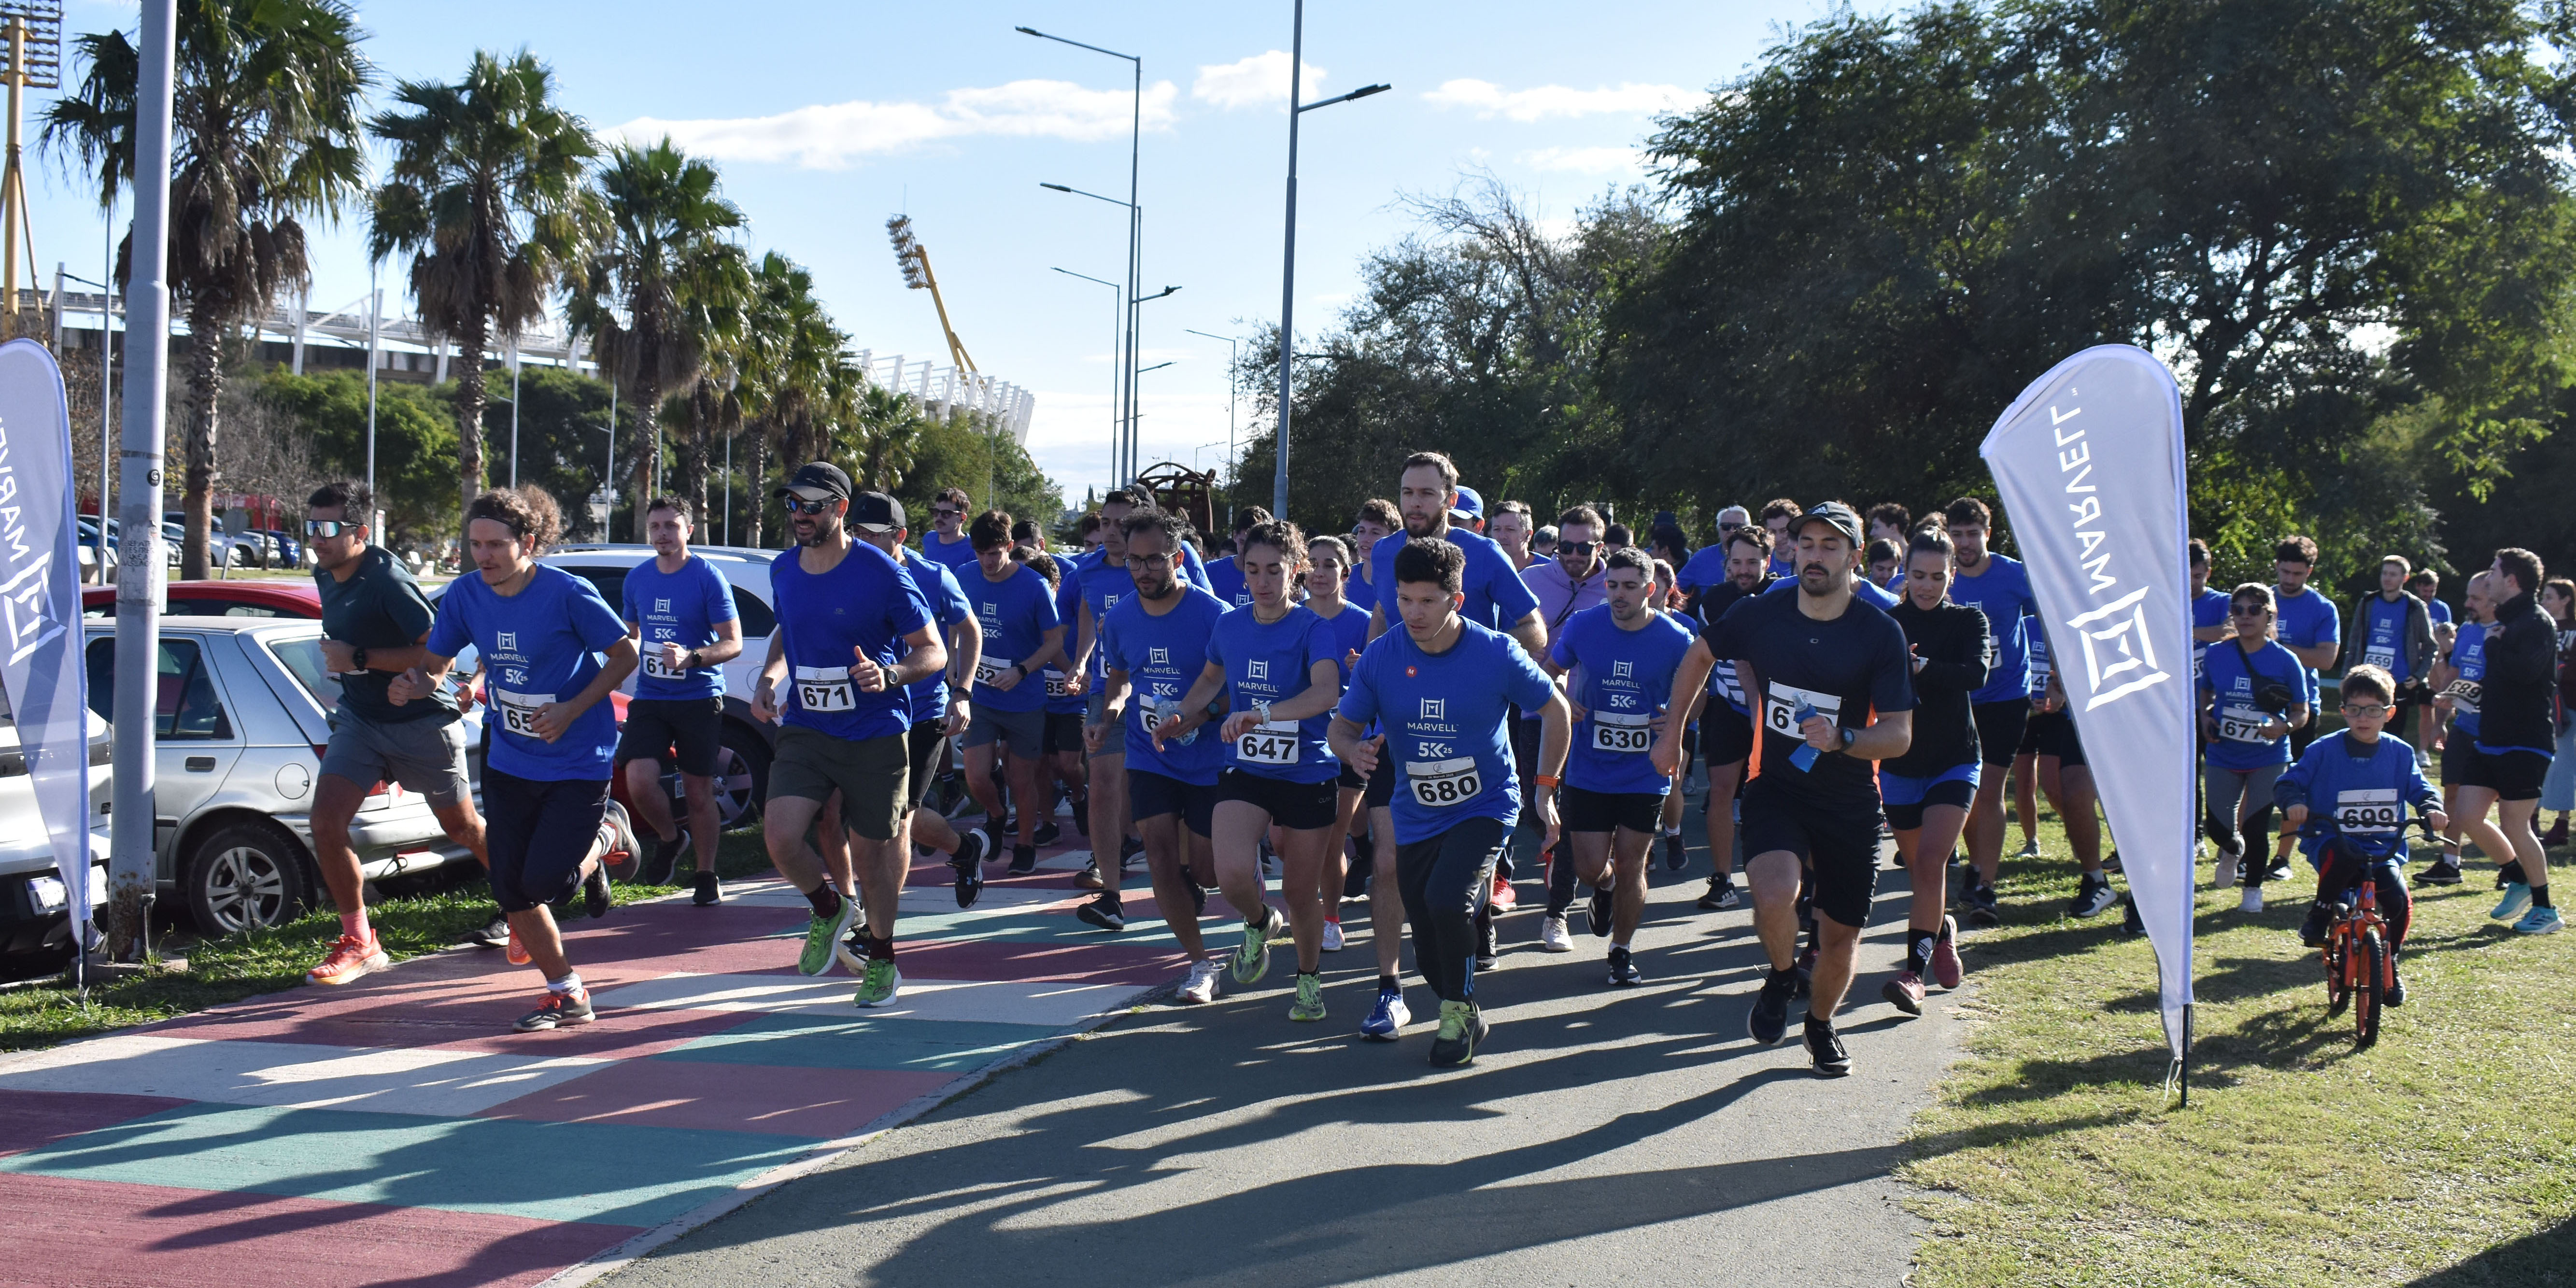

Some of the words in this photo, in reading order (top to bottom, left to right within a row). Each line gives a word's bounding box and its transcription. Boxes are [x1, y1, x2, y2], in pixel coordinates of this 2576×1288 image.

[490, 653, 528, 663] MARVELL
[976, 666, 995, 682] 62
[1602, 679, 1641, 689] MARVELL
[803, 686, 849, 707] 671
[1238, 681, 1278, 692] MARVELL
[507, 709, 532, 733] 65
[1407, 722, 1457, 732] MARVELL
[1242, 736, 1295, 760] 647
[1599, 728, 1647, 749] 630
[1417, 776, 1477, 803] 680
[2344, 808, 2394, 829] 699
